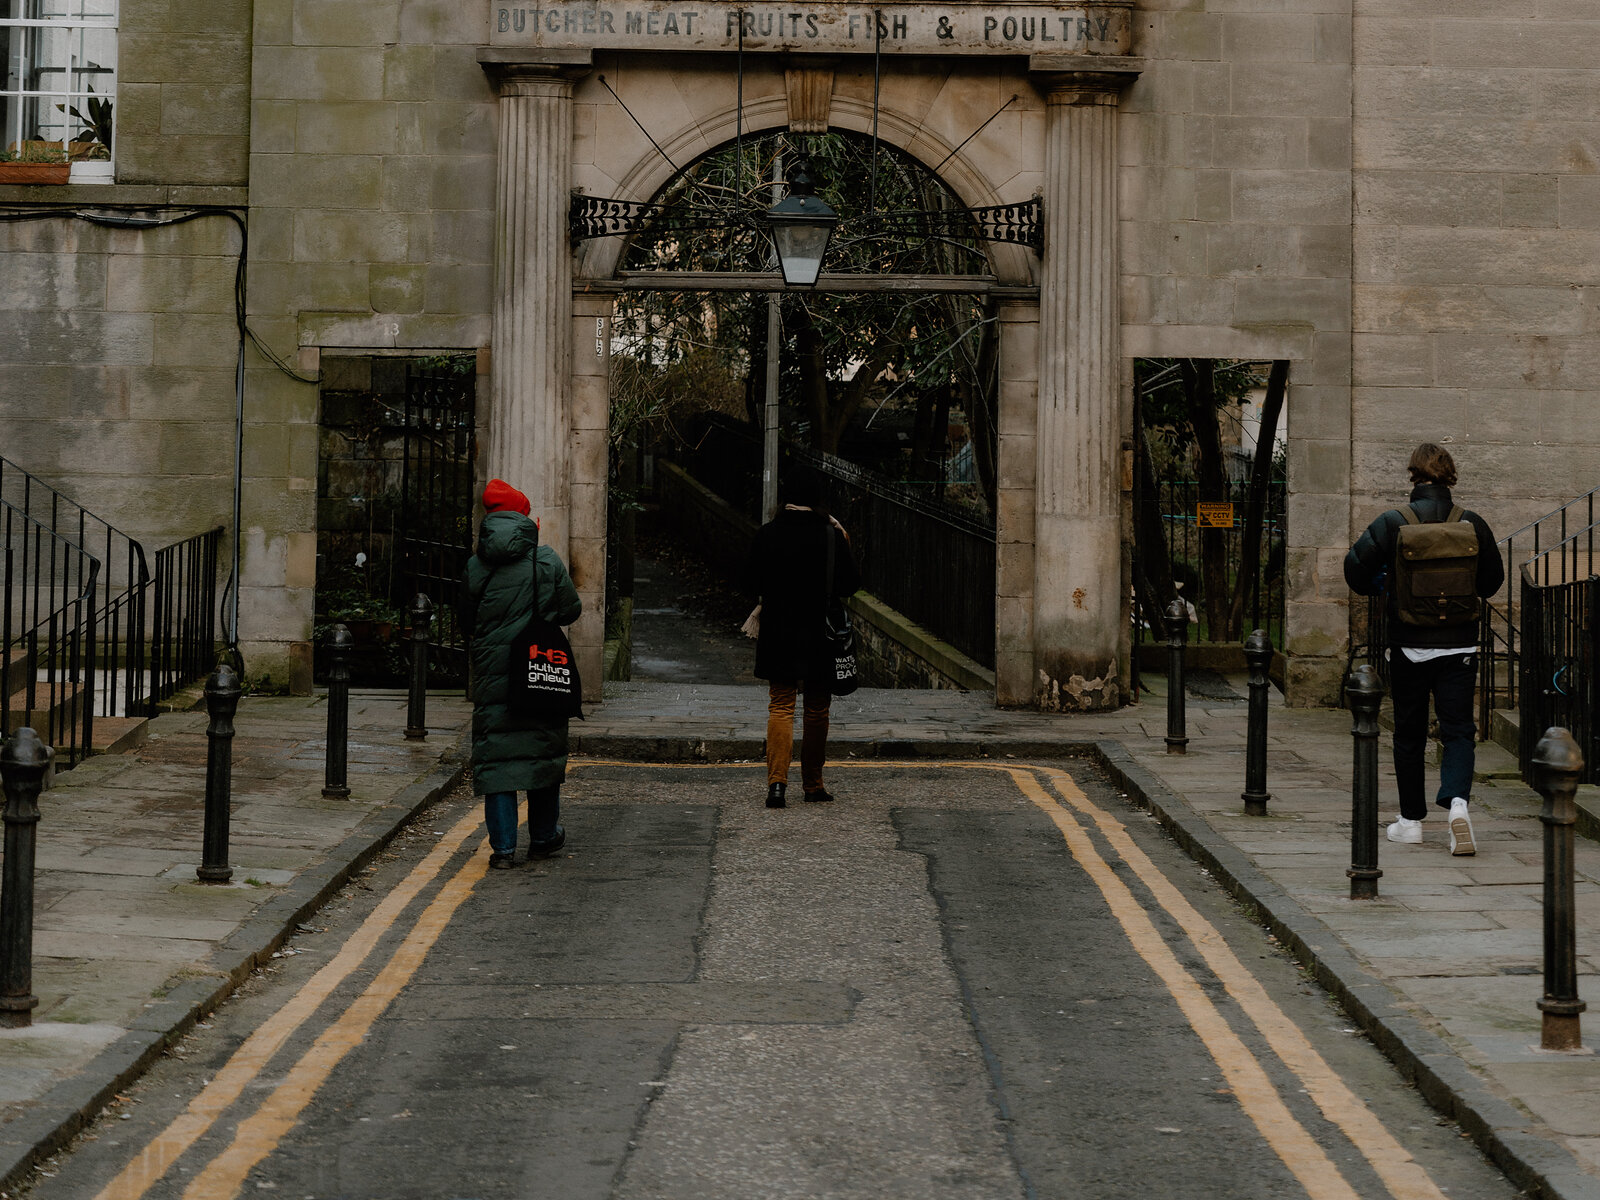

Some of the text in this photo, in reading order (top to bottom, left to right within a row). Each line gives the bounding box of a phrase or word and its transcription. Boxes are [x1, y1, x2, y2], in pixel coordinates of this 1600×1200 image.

[497, 8, 617, 35] BUTCHER
[848, 13, 908, 40] FISH
[935, 15, 954, 40] &
[528, 660, 571, 676] kultura
[836, 665, 857, 680] BAG
[528, 671, 571, 685] gniewu
